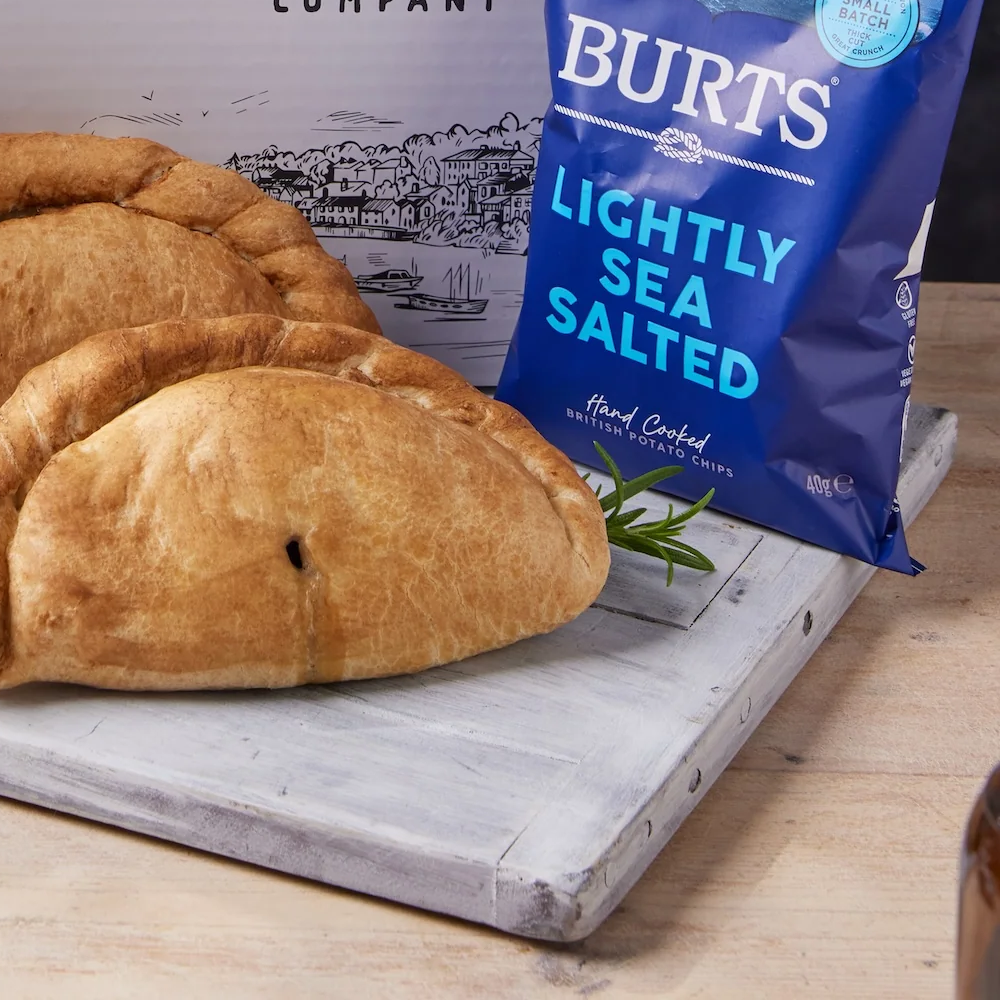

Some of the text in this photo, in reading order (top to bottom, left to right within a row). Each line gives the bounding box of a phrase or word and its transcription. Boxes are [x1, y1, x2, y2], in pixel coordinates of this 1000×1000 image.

[831, 33, 884, 56] GREAT CRUNCH
[839, 7, 889, 30] BATCH
[847, 28, 872, 41] THICK
[848, 37, 866, 47] CUT
[557, 13, 831, 150] BURTS
[551, 165, 796, 284] LIGHTLY
[599, 247, 712, 329] SEA
[545, 286, 759, 399] SALTED
[566, 408, 734, 478] BRITISH POTATO CHIPS
[586, 394, 711, 453] Hand Cooked
[806, 474, 833, 498] 40g
